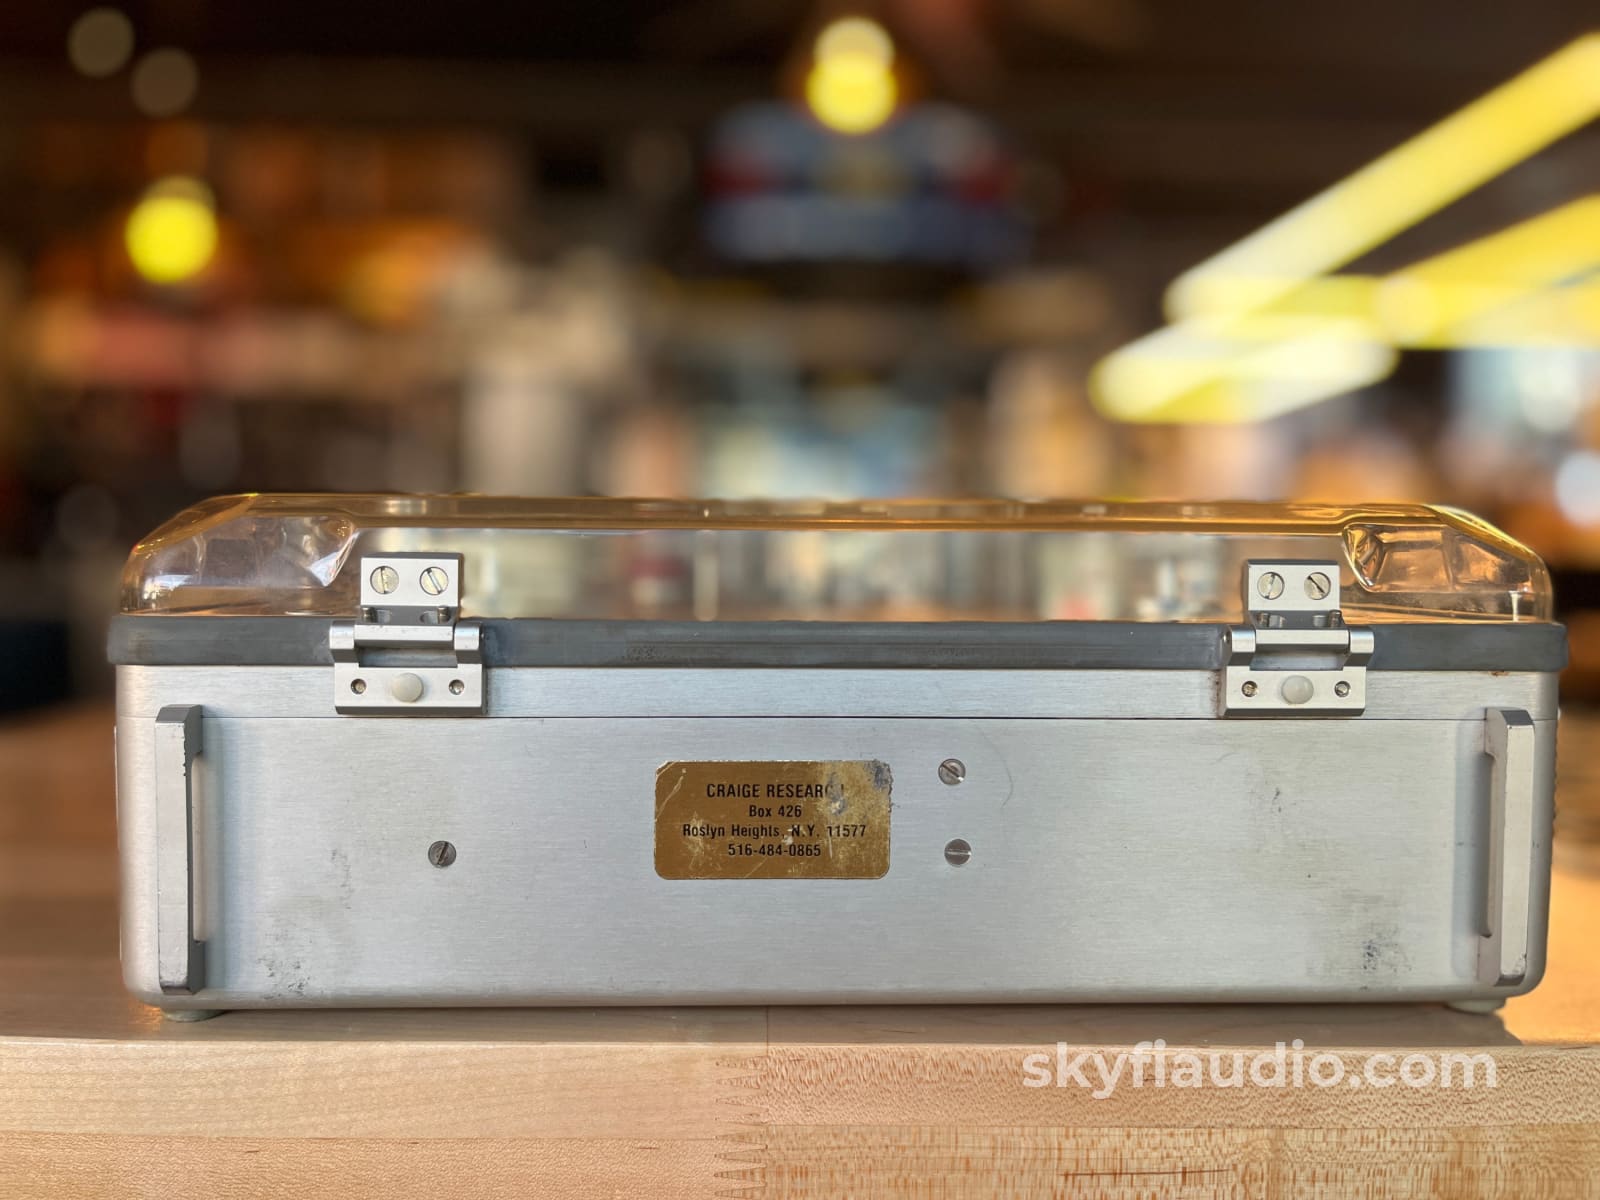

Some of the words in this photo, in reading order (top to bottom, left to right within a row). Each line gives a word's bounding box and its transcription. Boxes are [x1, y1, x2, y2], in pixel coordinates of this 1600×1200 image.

[706, 783, 761, 798] CRAIGE
[766, 783, 844, 798] RESEAR
[749, 805, 772, 818] Box
[778, 805, 802, 818] 426
[683, 824, 725, 839] Roslyn
[791, 824, 820, 837] N.Y.
[827, 824, 866, 837] 11577
[728, 844, 821, 856] 516-484-0865
